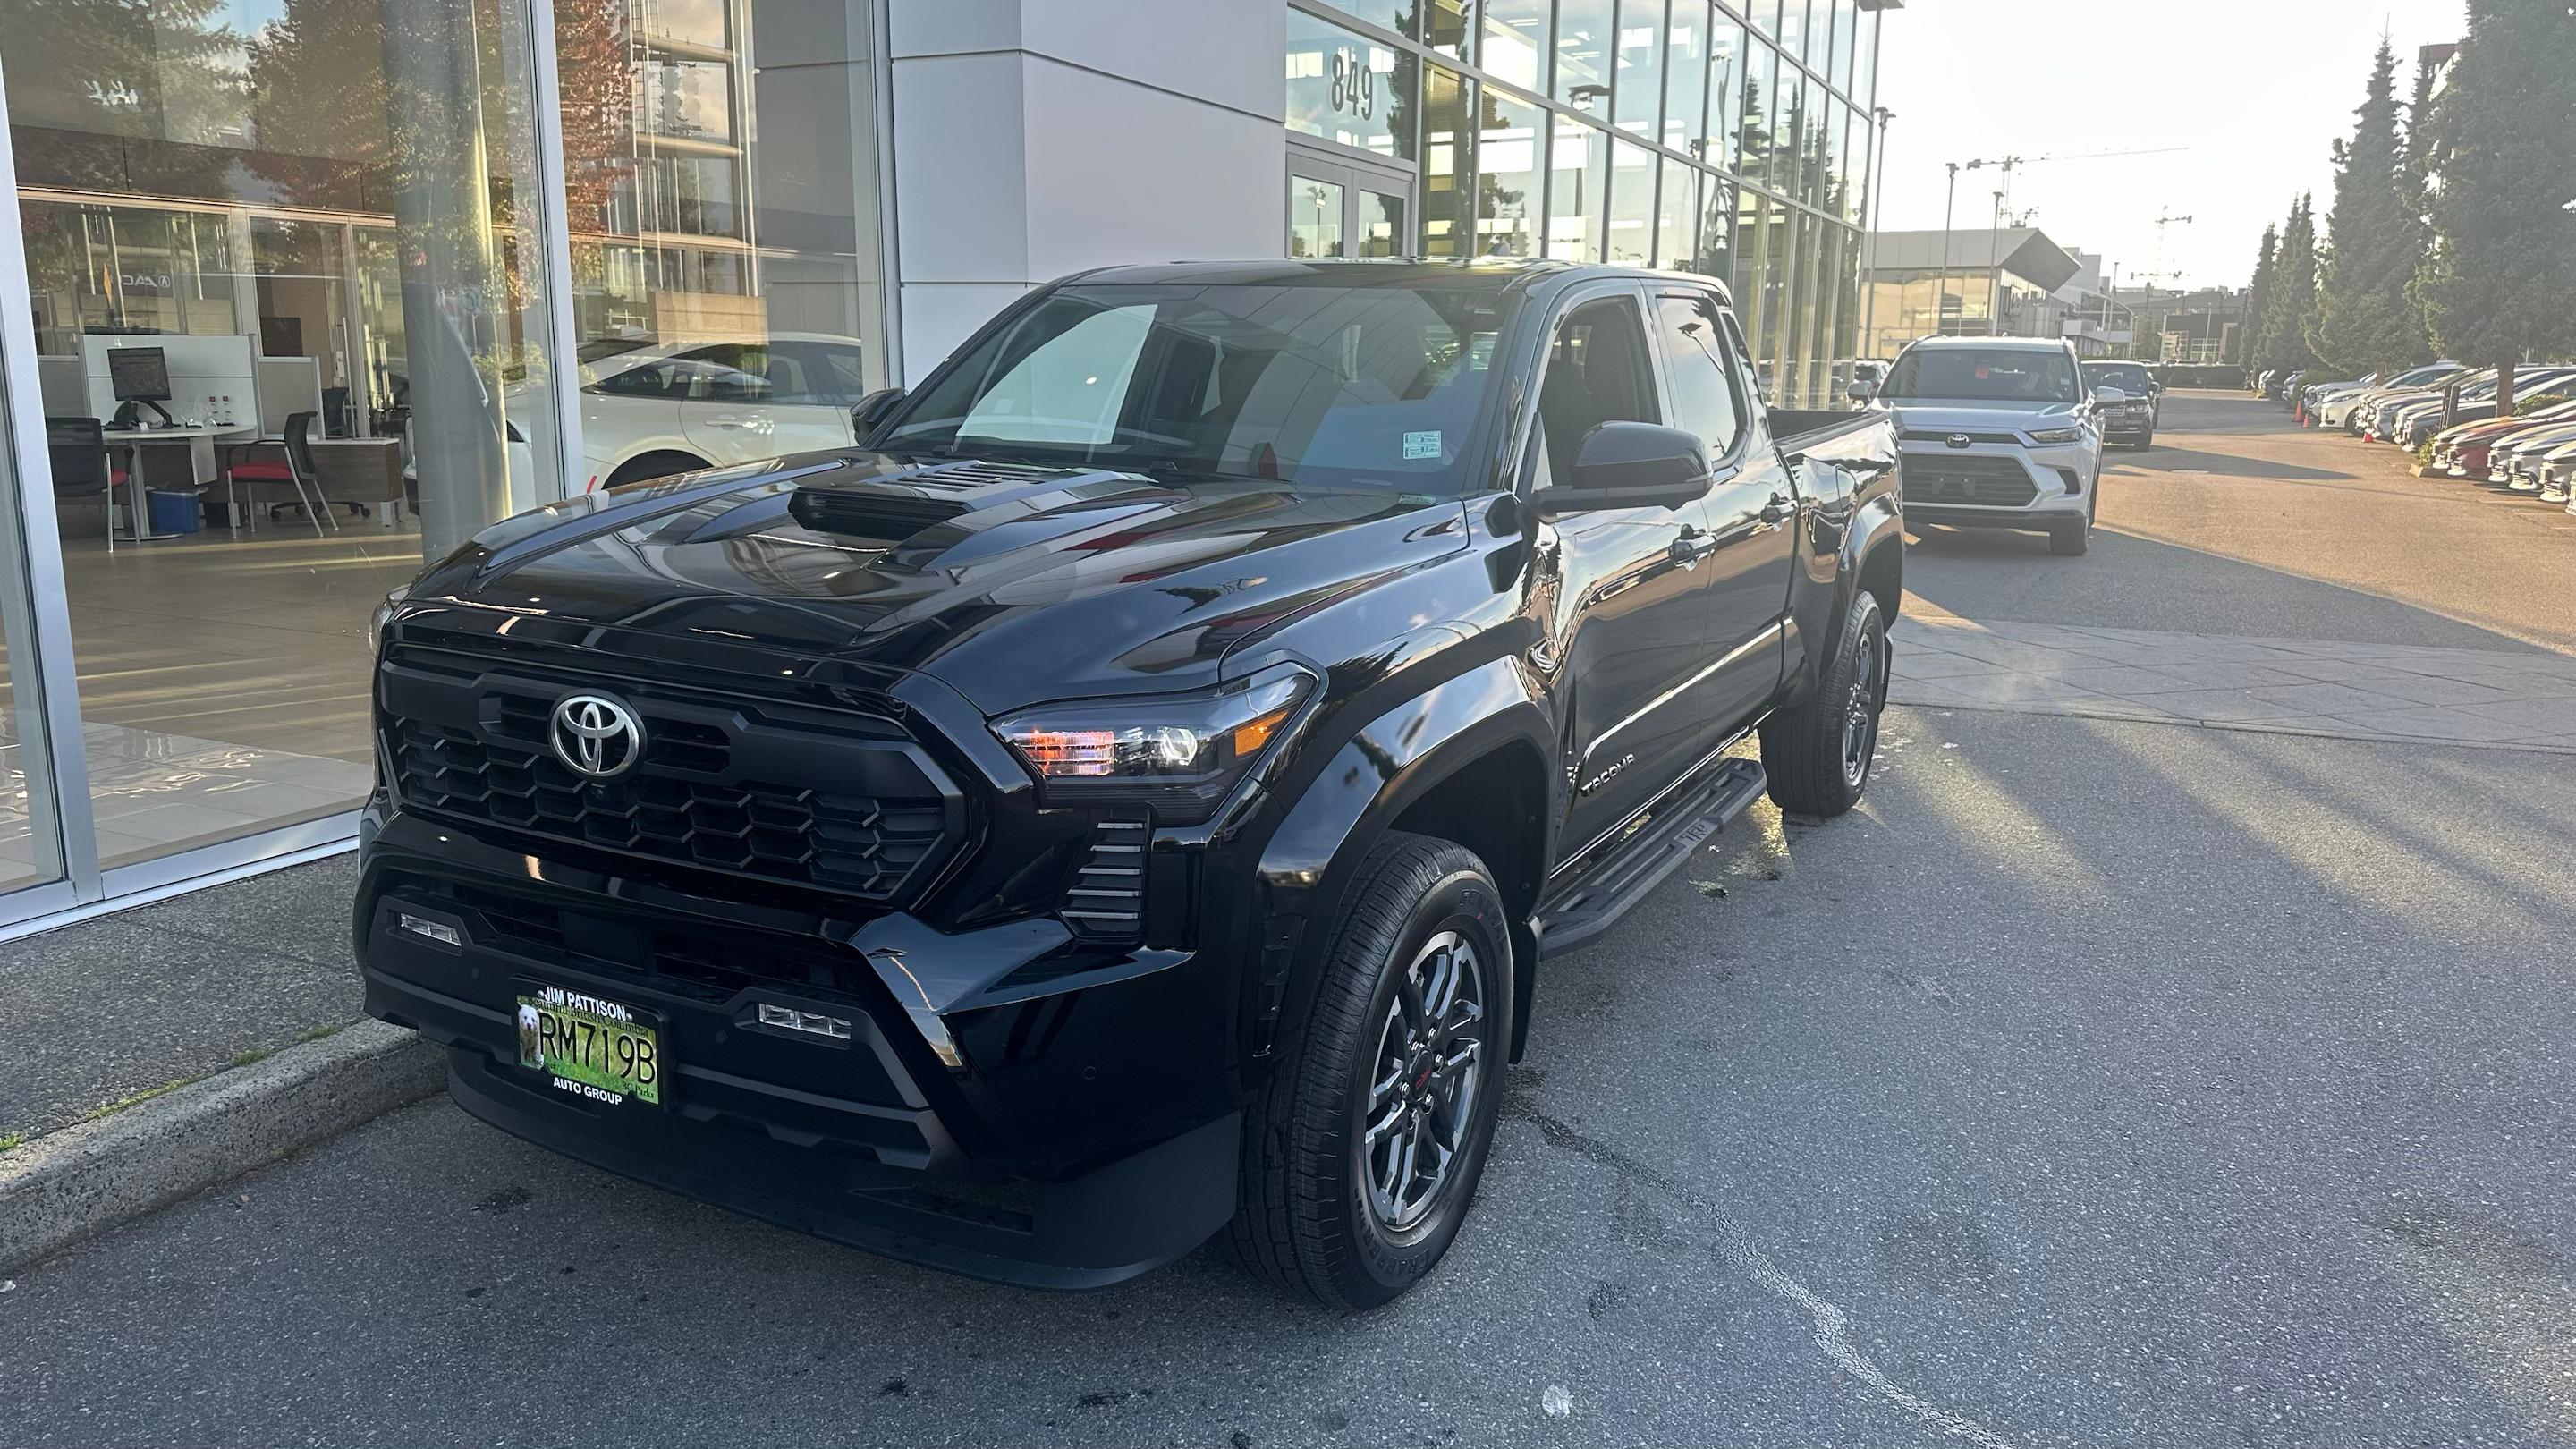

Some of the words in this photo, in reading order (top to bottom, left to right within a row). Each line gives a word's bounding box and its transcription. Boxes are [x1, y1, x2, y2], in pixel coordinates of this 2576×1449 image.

[1331, 54, 1373, 121] 849
[1580, 753, 1635, 795] TACOMA
[544, 987, 564, 1005] JIM
[567, 991, 626, 1021] PATTISON
[572, 1006, 600, 1023] British
[603, 1016, 648, 1037] Columbia
[538, 1012, 656, 1084] RM719B
[553, 1077, 581, 1094] AUTO
[584, 1085, 623, 1106] GROUP
